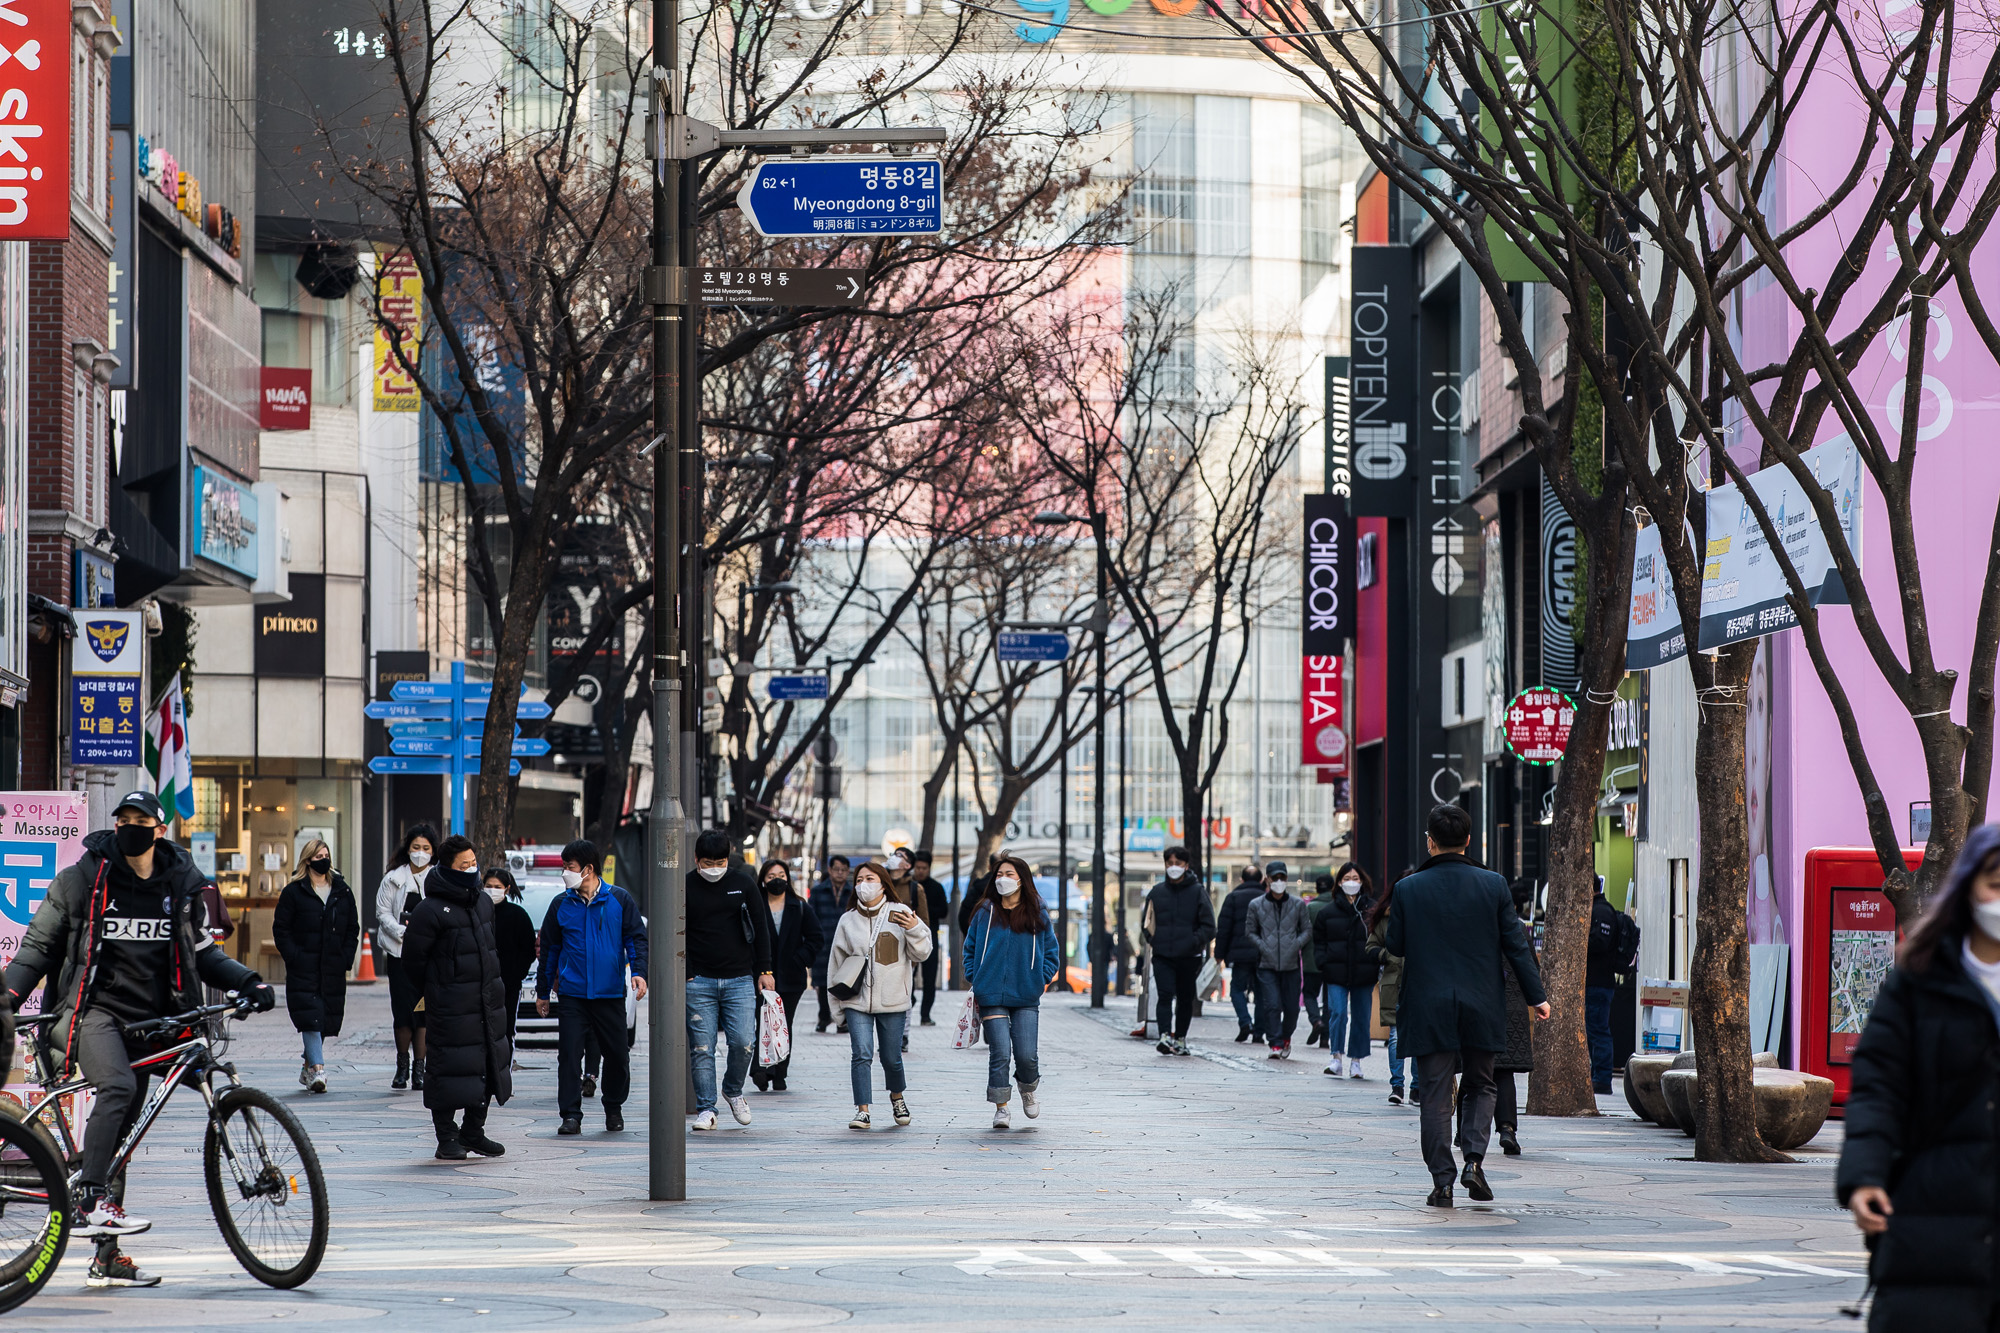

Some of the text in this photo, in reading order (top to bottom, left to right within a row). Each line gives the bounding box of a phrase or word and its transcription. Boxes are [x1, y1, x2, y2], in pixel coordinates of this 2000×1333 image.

[0, 88, 43, 225] skin
[762, 177, 796, 189] 62 1
[860, 166, 935, 190] 명동8길
[794, 195, 935, 213] Myeongdong 8-gil
[813, 218, 935, 231] 明洞8街 ミョンドン8ギル
[265, 386, 308, 405] NANTA
[1309, 517, 1338, 632] CHICOR
[263, 611, 318, 636] primera
[79, 681, 135, 692] 남대문경찰서
[79, 717, 134, 734] 파출소
[87, 749, 132, 757] 2096-8473
[12, 803, 78, 821] 오아시스
[14, 821, 79, 839] Massage
[26, 1211, 63, 1283] CRUISER
